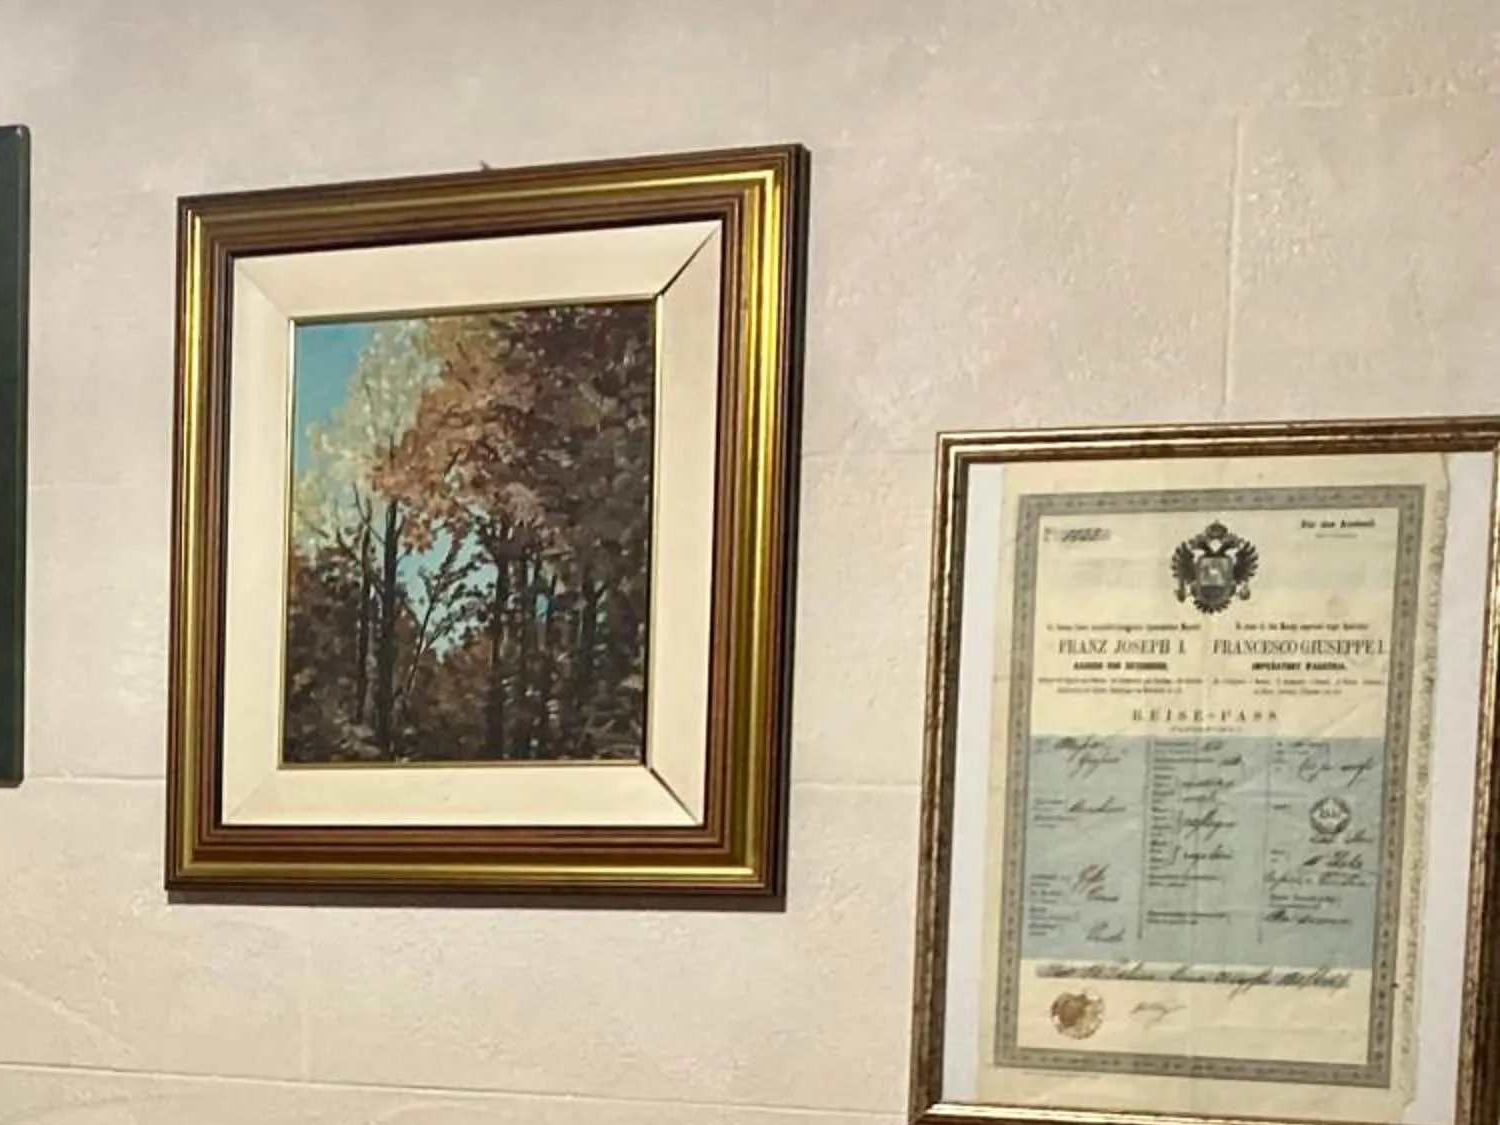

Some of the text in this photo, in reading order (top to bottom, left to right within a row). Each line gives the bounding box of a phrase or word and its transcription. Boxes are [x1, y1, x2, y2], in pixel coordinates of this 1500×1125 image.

[1059, 639, 1108, 655] FRANZ
[1113, 639, 1171, 655] JOSEPH
[1213, 639, 1298, 655] FRANCESCO
[1300, 639, 1375, 656] GIUSEPPE
